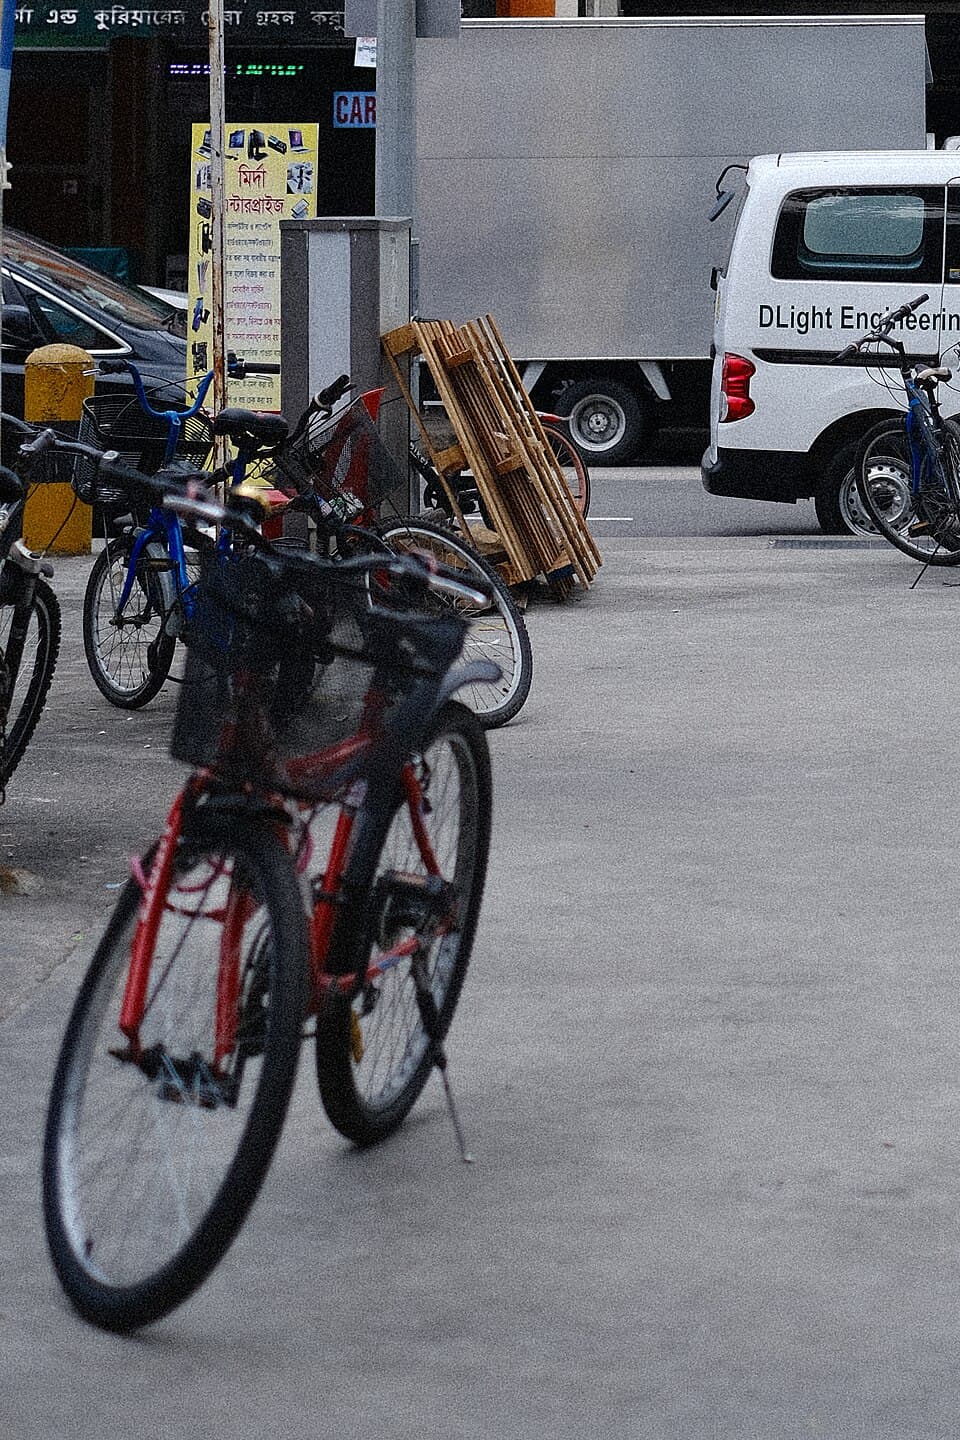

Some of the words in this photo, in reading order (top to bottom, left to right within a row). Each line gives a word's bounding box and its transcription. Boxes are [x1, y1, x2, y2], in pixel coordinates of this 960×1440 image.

[45, 9, 80, 25] এন্ড
[226, 193, 285, 215] ন্টারপ্রাইজ
[758, 304, 833, 335] DLight
